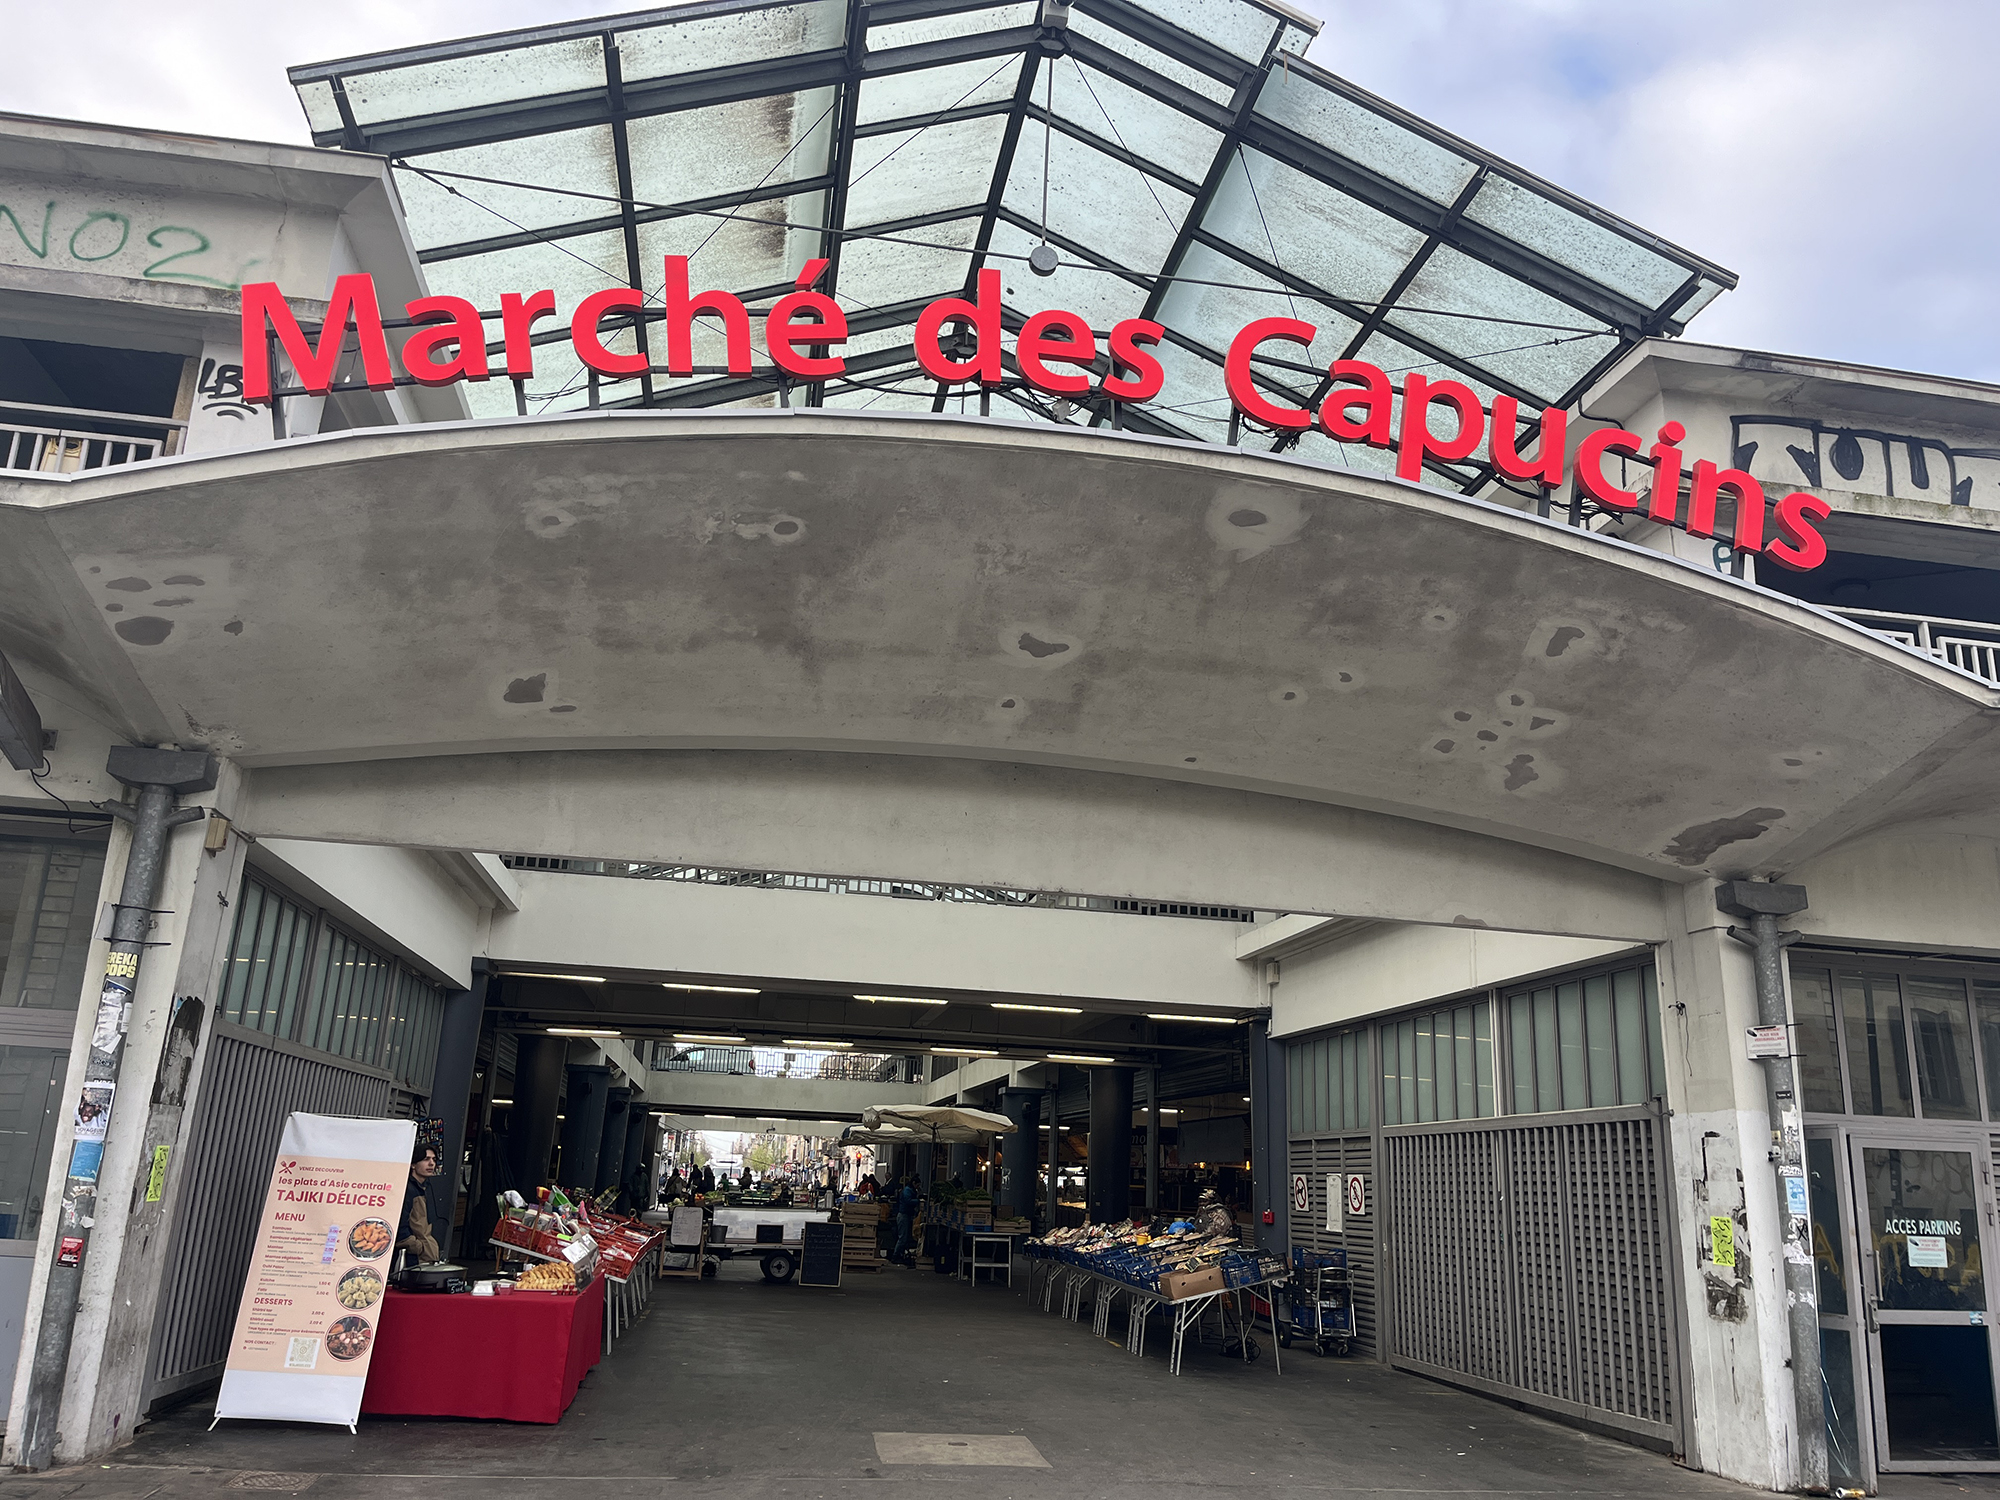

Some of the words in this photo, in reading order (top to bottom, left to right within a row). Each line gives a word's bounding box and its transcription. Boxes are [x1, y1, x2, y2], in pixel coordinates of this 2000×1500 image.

[241, 255, 849, 404] Marché
[914, 268, 1166, 403] des
[1223, 317, 1832, 572] Capucins
[279, 1176, 292, 1184] les
[294, 1178, 318, 1187] plats
[320, 1179, 350, 1188] d'Asie
[351, 1181, 392, 1191] centrale
[277, 1189, 324, 1203] TAJIKI
[326, 1190, 386, 1207] DÉLICES
[275, 1212, 306, 1221] MENU
[1919, 1219, 1962, 1235] PARKING
[254, 1297, 294, 1306] DESSERTS
